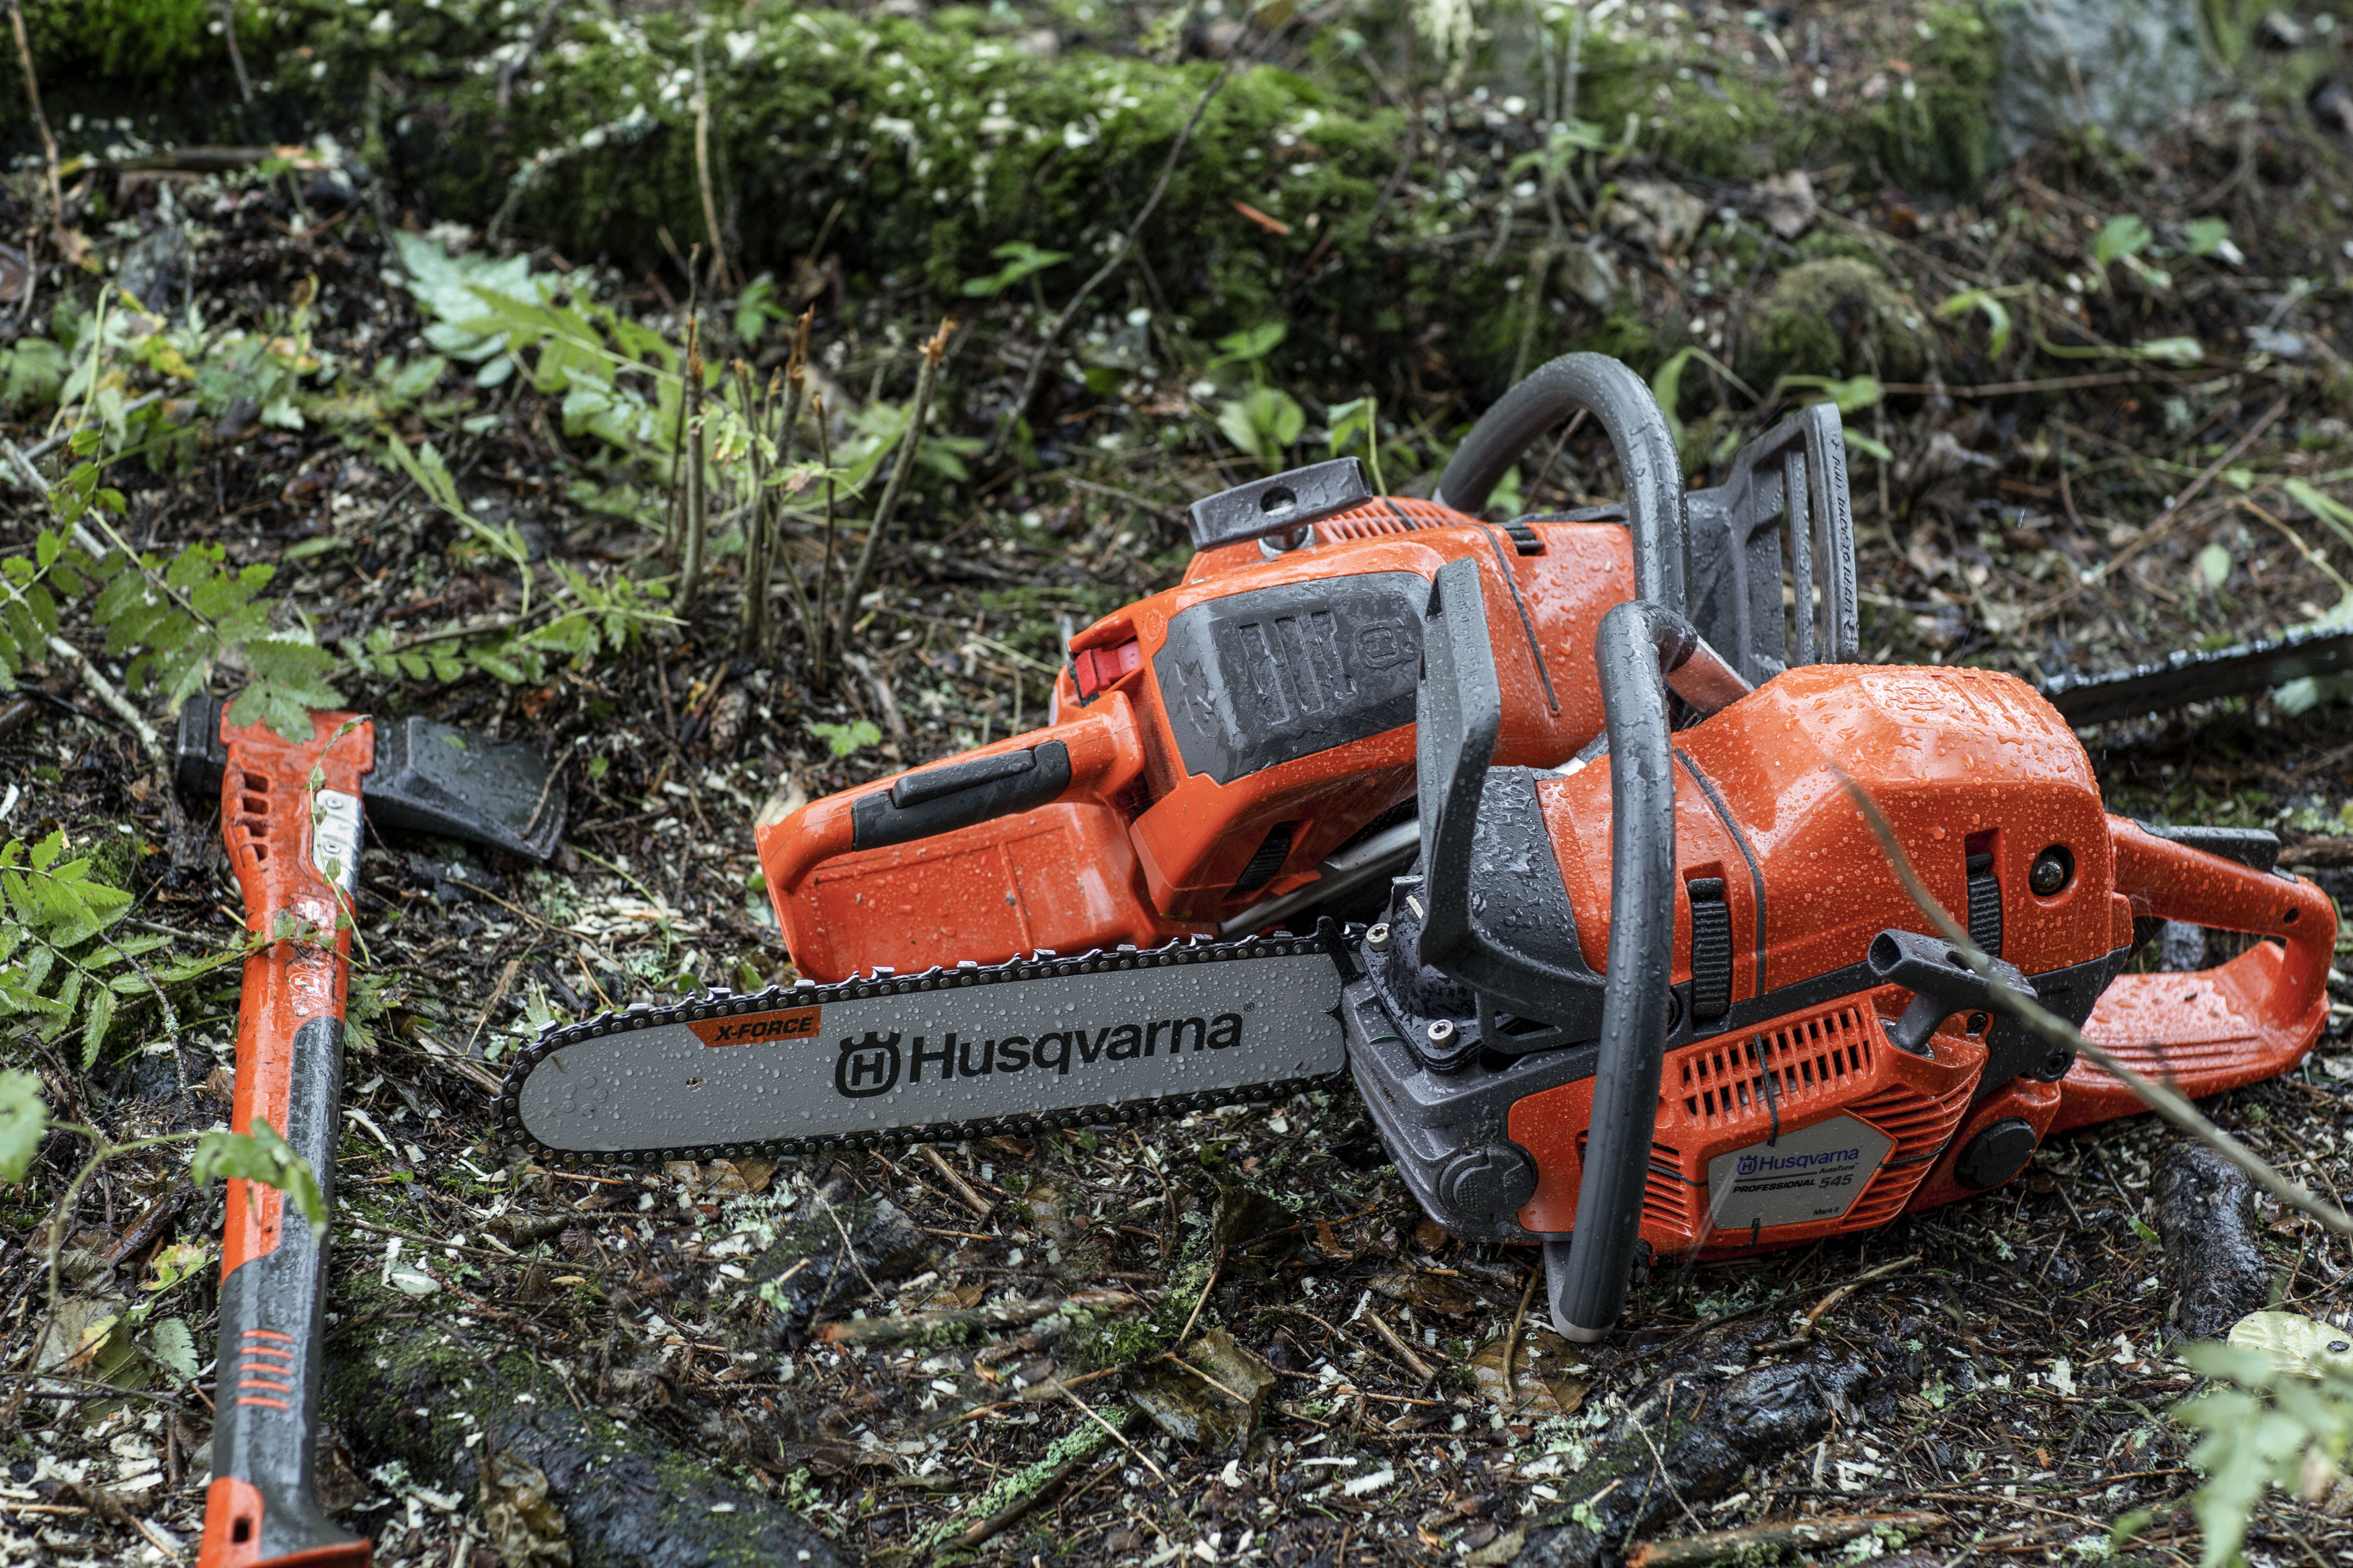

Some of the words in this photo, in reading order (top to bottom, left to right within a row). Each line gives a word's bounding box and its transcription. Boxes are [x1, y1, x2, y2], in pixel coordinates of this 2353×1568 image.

[714, 1017, 813, 1041] X-FORCE
[1759, 1148, 1860, 1170] Husqvarna
[1732, 1178, 1815, 1193] PROFESSIONAL
[1819, 1174, 1853, 1188] 545
